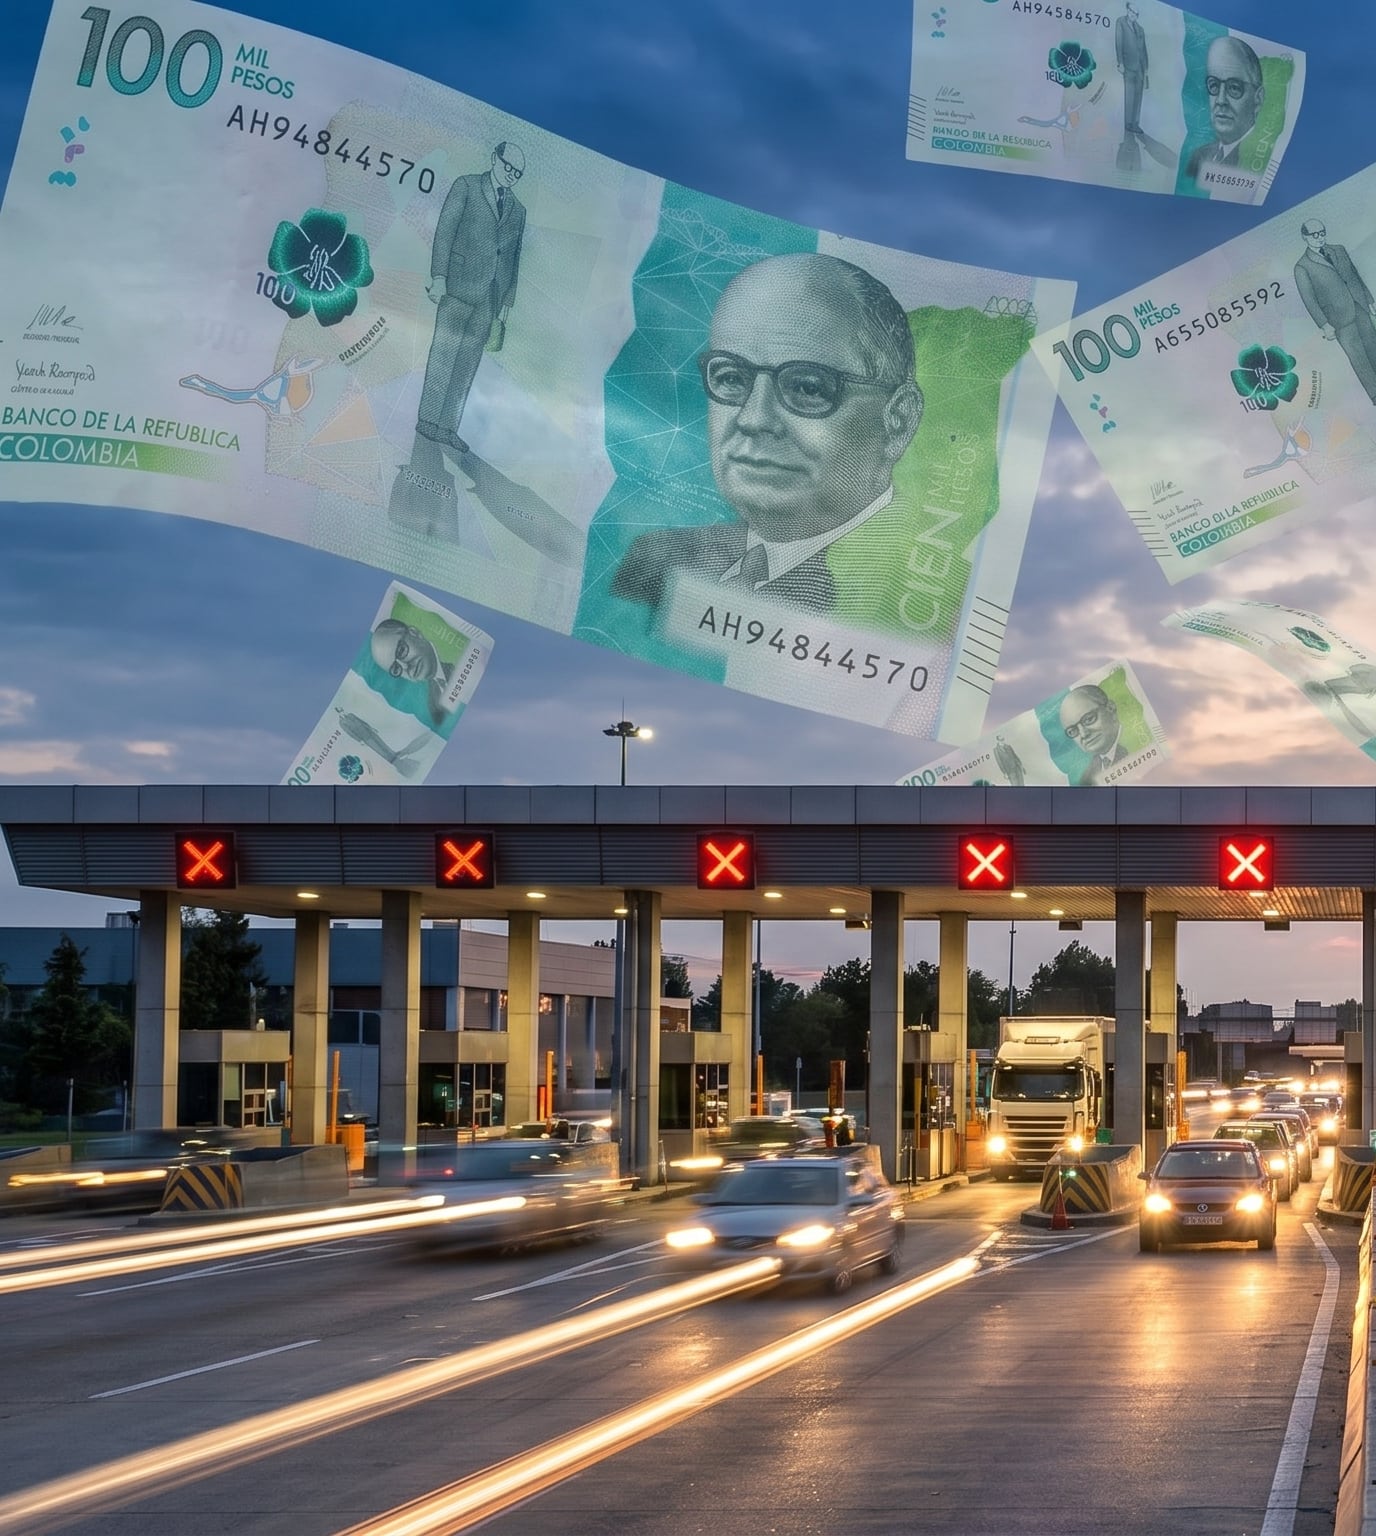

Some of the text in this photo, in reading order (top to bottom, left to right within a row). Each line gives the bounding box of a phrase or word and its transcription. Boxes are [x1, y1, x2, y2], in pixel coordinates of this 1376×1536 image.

[76, 6, 223, 109] 100
[235, 43, 270, 70] MIL
[231, 65, 296, 100] PESOS
[226, 104, 436, 194] AH94844570
[255, 271, 296, 305] 100
[1154, 281, 1285, 354] A655085592
[1052, 314, 1141, 382] 100
[1, 406, 77, 428] BANCO
[83, 410, 109, 430] DE
[113, 413, 137, 434] LA
[0, 434, 140, 468] COLOMBIA
[1169, 518, 1211, 543] BANCO
[899, 505, 963, 631] CIEN
[697, 604, 929, 693] AH94844570
